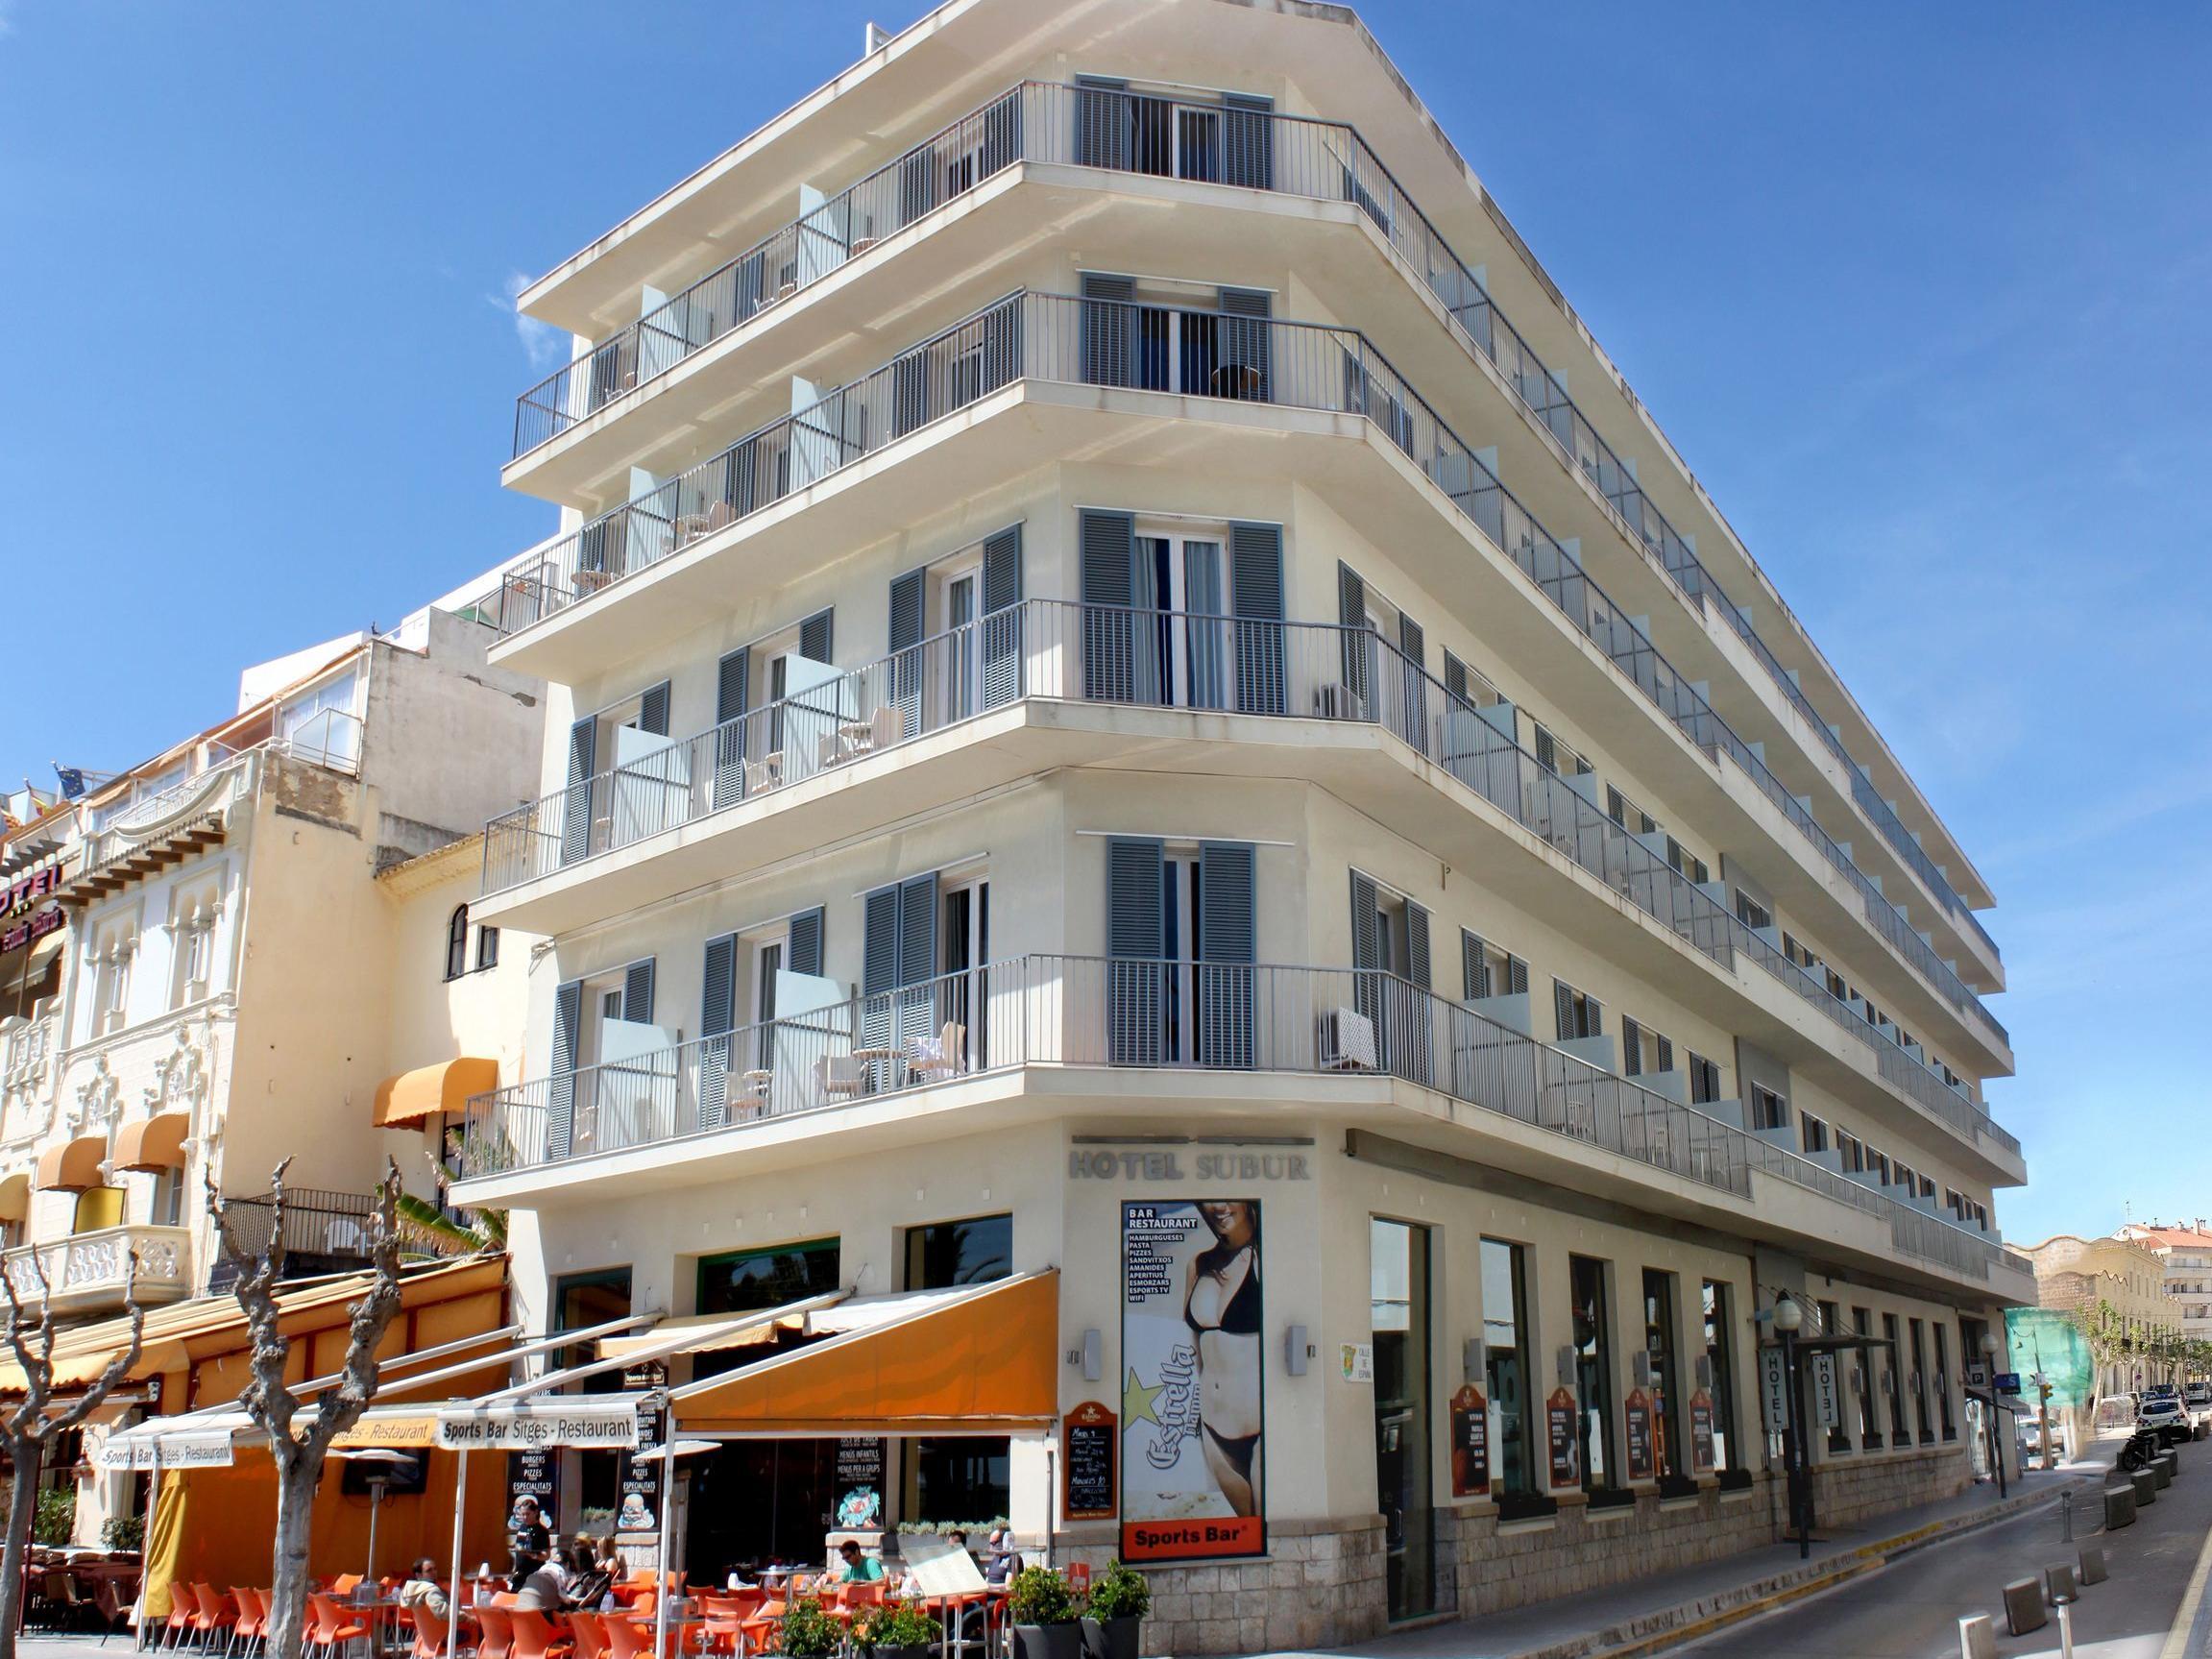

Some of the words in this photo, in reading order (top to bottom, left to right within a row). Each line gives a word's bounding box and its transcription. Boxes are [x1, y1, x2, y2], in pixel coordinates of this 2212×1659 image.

[1069, 1152, 1184, 1181] HOTEL
[1197, 1154, 1311, 1181] SUBUR
[1129, 1208, 1154, 1218] BAR
[1129, 1219, 1197, 1229] RESTAURANT
[1768, 1357, 1782, 1424] HOTEL
[1146, 1344, 1197, 1470] Estrella
[370, 1424, 428, 1440] Restaurant
[444, 1423, 480, 1441] Sports
[487, 1422, 508, 1437] Bar
[513, 1421, 547, 1444] Sitges
[558, 1419, 632, 1437] Restaurant
[102, 1450, 134, 1464] Sports
[137, 1449, 153, 1462] Bar
[185, 1445, 231, 1461] Restaurant
[513, 1481, 552, 1490] ESPECIALITATS
[1134, 1528, 1201, 1548] Sports
[1205, 1526, 1240, 1543] Bar
